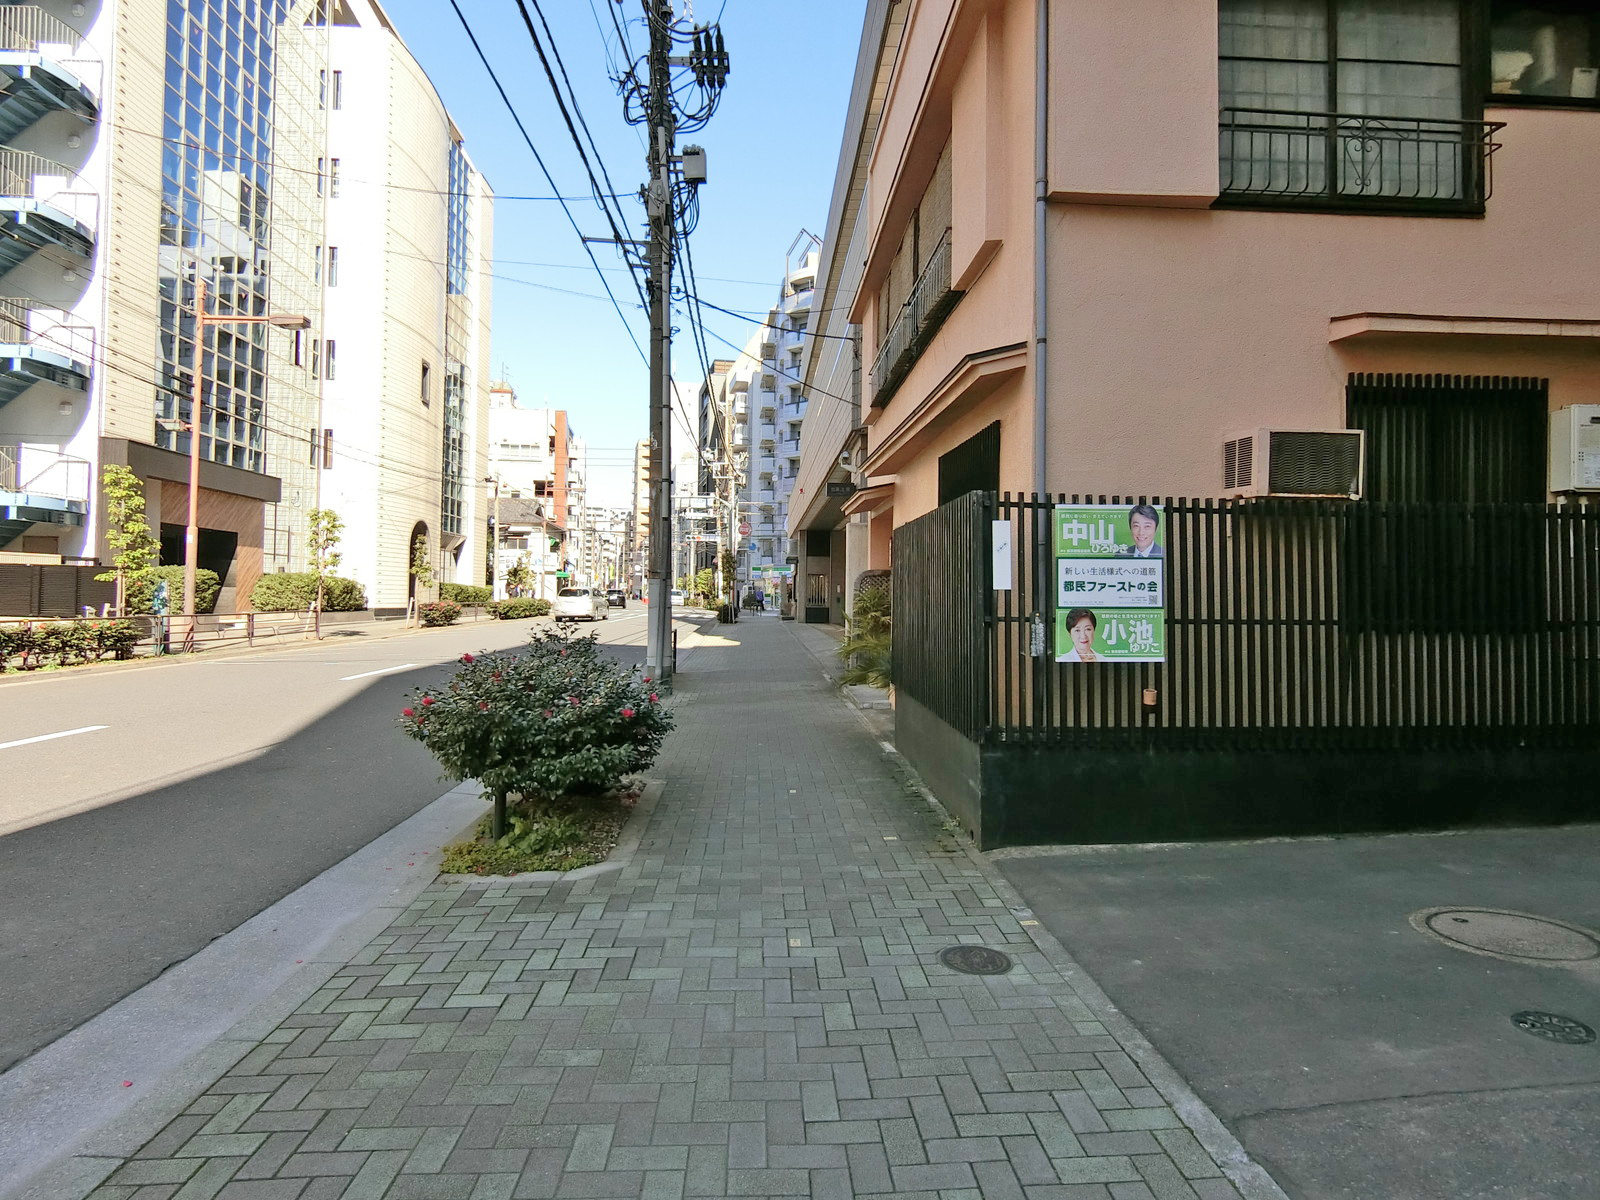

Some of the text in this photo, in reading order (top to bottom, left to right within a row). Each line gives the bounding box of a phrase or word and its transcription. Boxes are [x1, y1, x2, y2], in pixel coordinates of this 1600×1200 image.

[1063, 519, 1115, 547] 中山
[1091, 543, 1129, 553] ひろゆき
[1065, 567, 1156, 576] 新しい生活様式への道筋
[1063, 581, 1158, 592] 都民ファーストの会
[1102, 619, 1153, 645] 小池
[1130, 643, 1160, 653] ゆりこ
